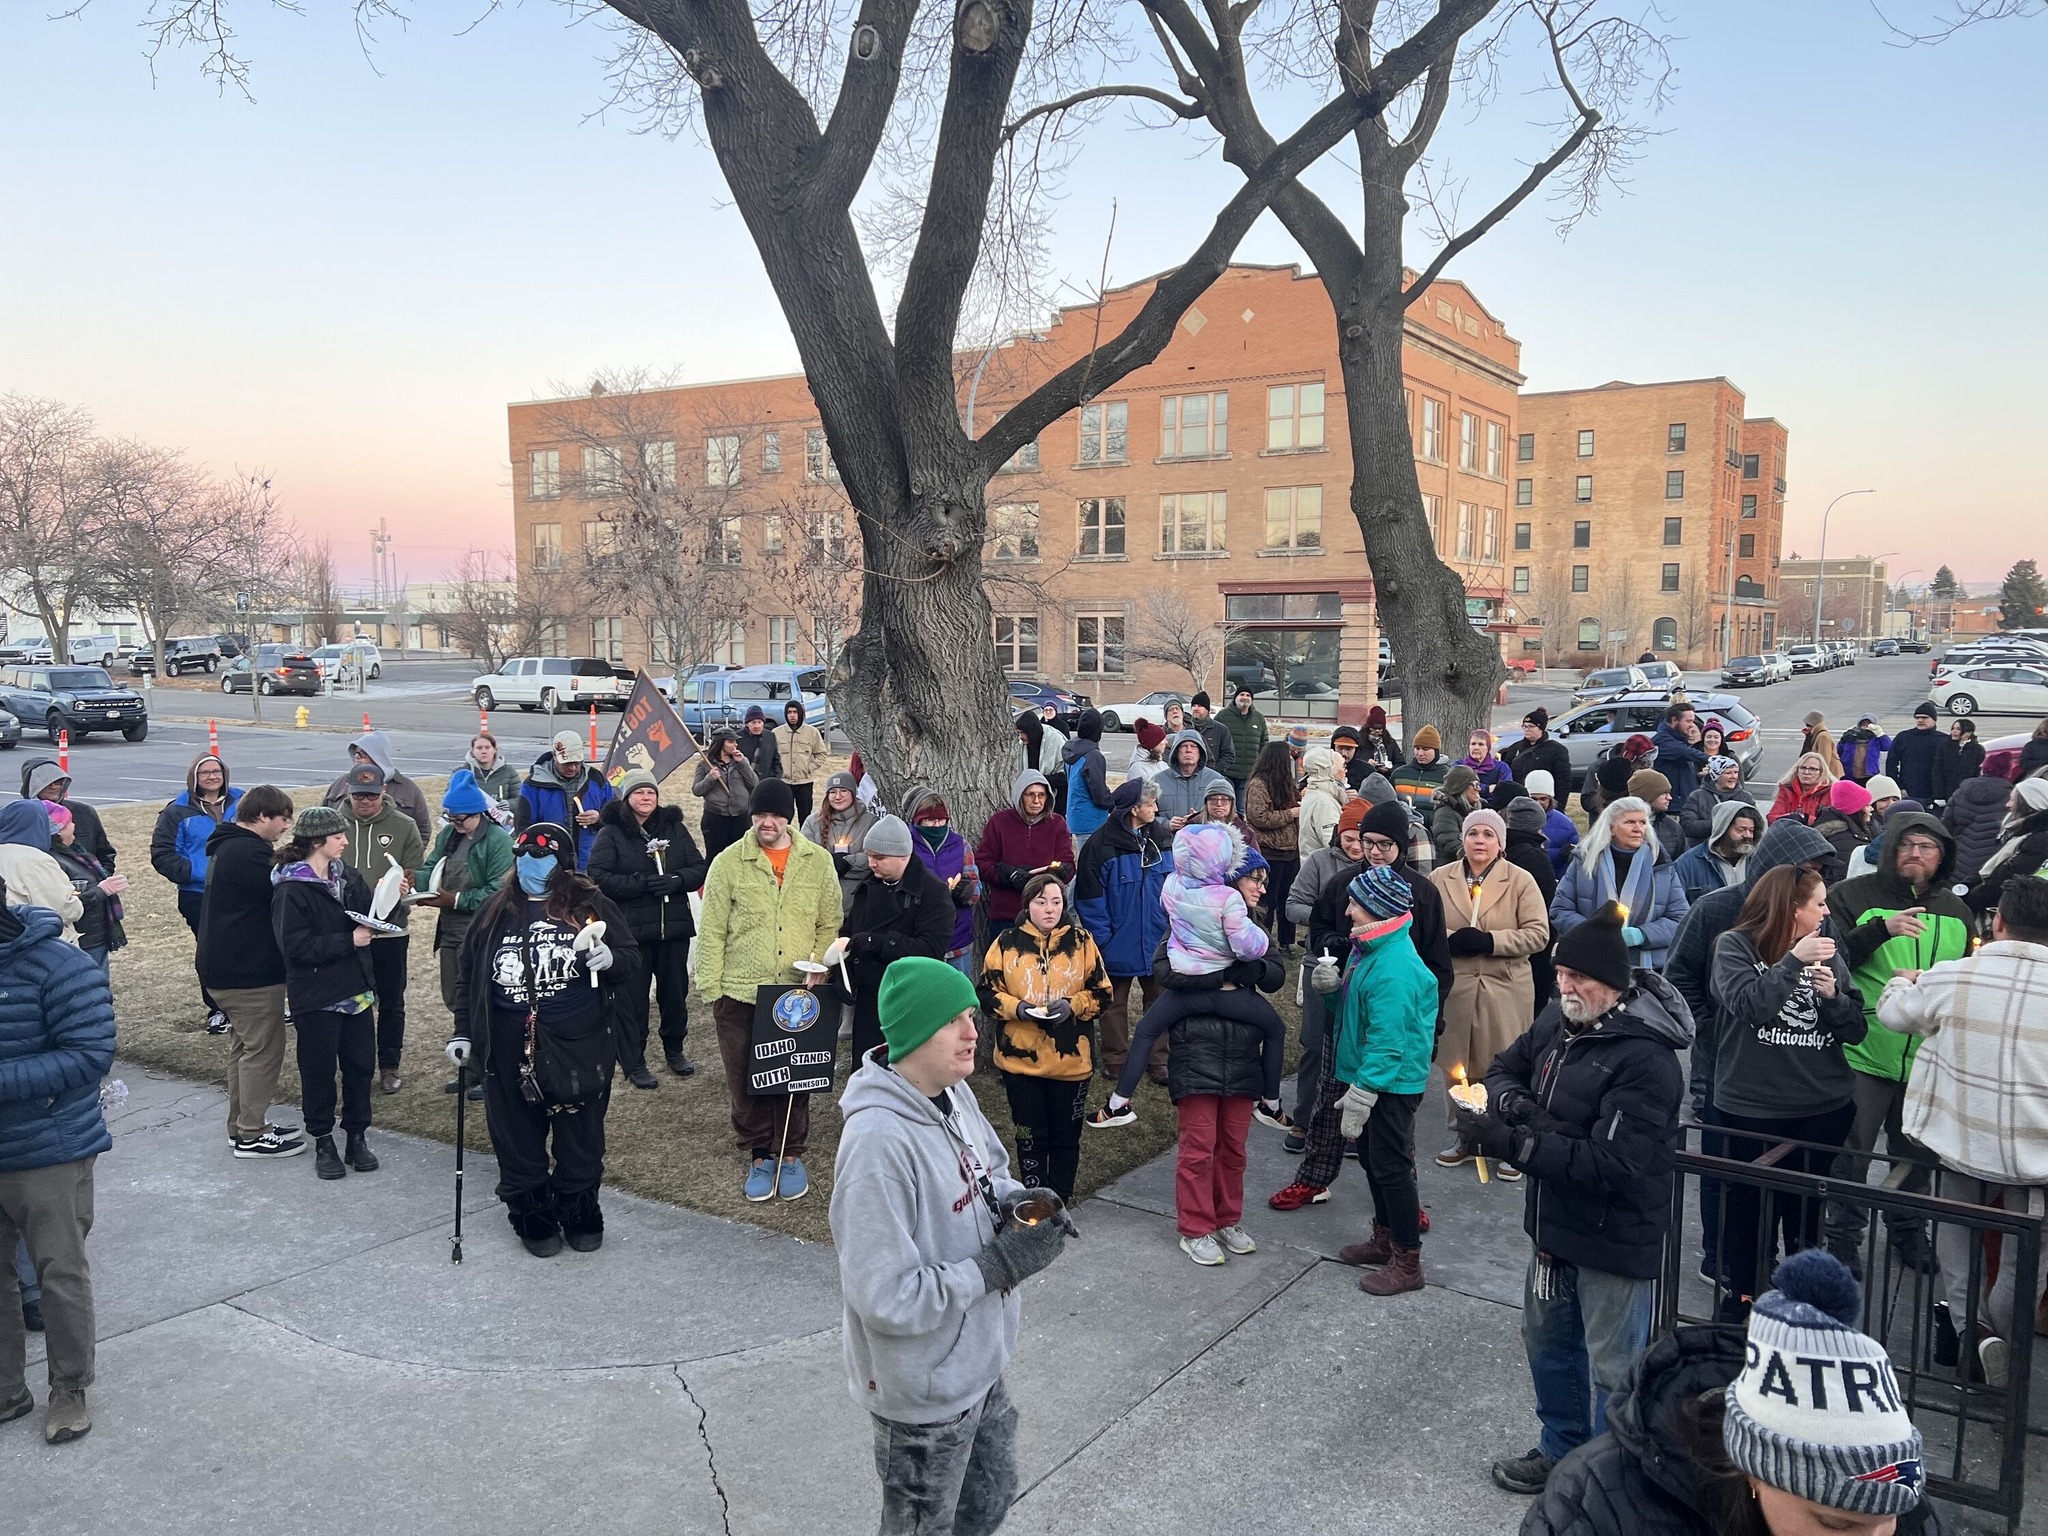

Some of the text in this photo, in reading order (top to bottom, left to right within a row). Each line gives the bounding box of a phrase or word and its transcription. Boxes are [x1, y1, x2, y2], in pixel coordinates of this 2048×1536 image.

[537, 934, 555, 942] ME
[558, 933, 575, 941] UP
[757, 1040, 796, 1058] IDAHO
[792, 1052, 830, 1064] STANDS
[754, 1068, 790, 1088] WITH
[789, 1079, 828, 1090] MINNESOTA
